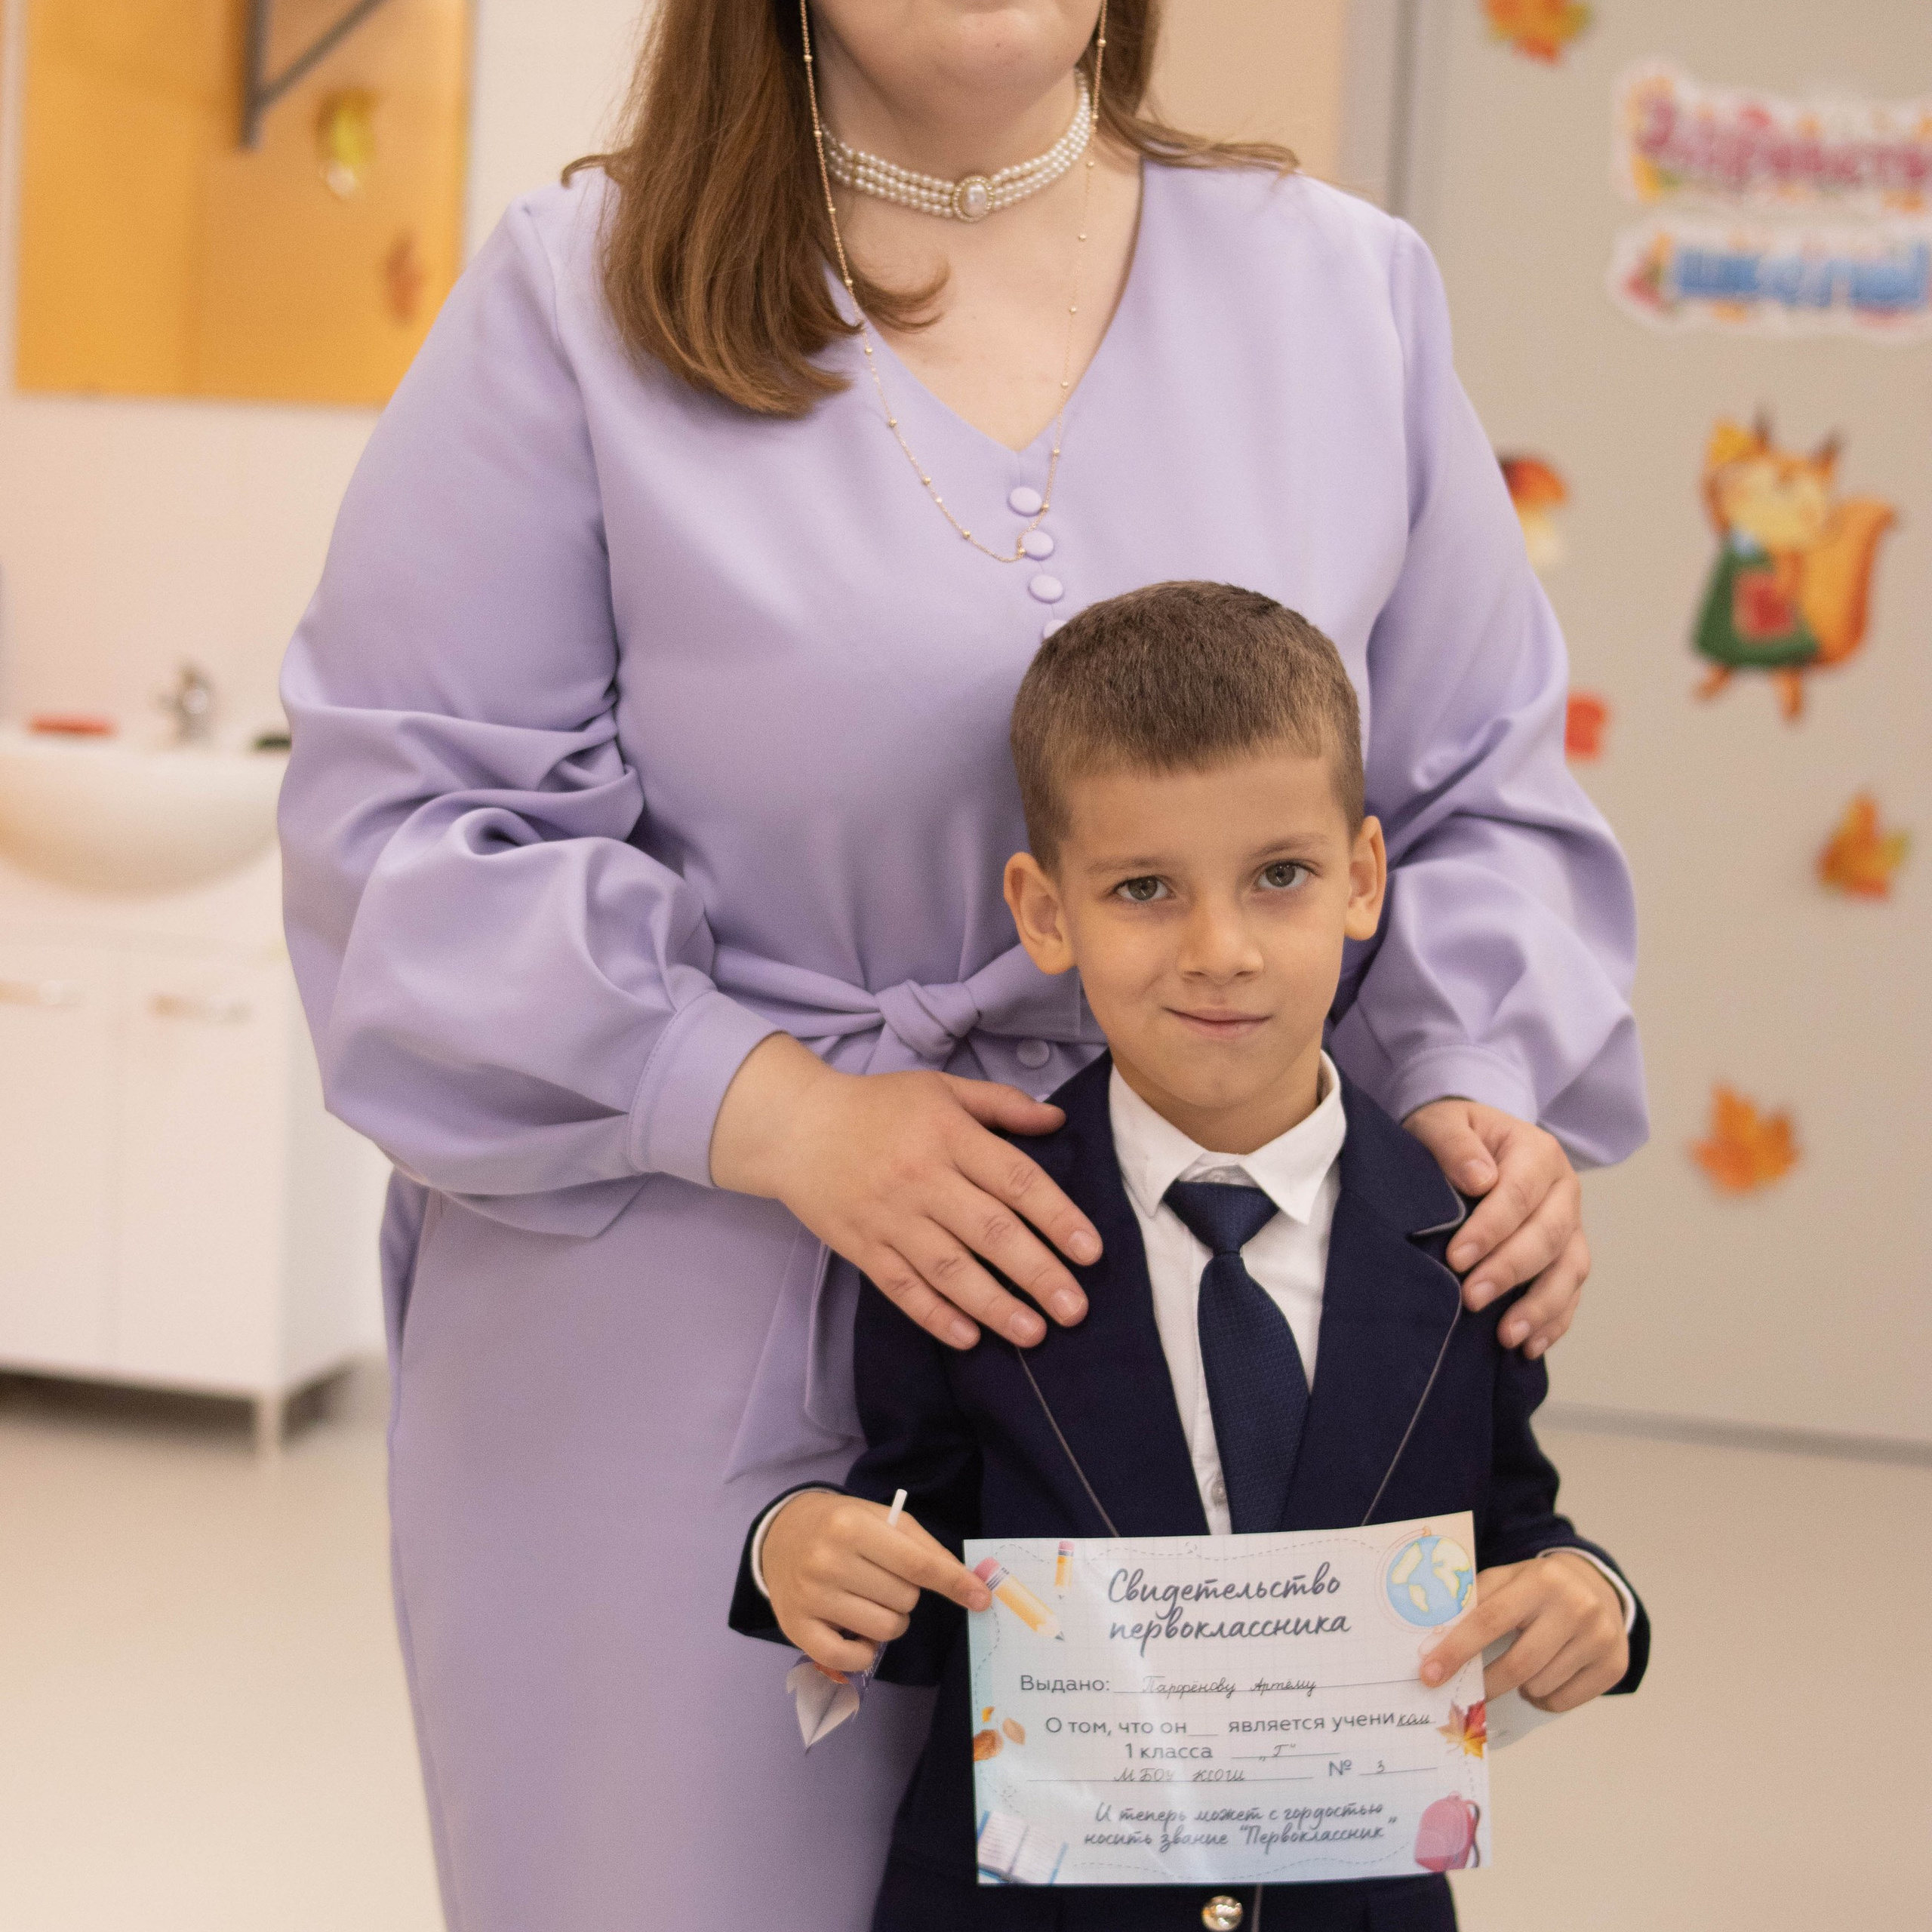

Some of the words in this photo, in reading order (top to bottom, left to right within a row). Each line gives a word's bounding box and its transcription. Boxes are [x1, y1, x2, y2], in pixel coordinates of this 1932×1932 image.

[1108, 1561, 1341, 1620] Свидетельство
[1109, 1606, 1352, 1657] первоклассника
[1020, 1675, 1110, 1693] Выдано:
[1045, 1717, 1062, 1734] О
[1068, 1721, 1112, 1736] том,
[1118, 1721, 1153, 1734] что
[1160, 1721, 1187, 1734] он
[1228, 1716, 1324, 1733] является
[1125, 1743, 1133, 1758] 1
[1140, 1746, 1214, 1759] класса
[1328, 1759, 1353, 1777] №
[1376, 1759, 1386, 1774] 3
[1096, 1801, 1112, 1822] И
[1118, 1807, 1187, 1832] теперь
[1193, 1807, 1263, 1823] может
[1269, 1809, 1278, 1820] с
[1284, 1801, 1383, 1830] гордостью
[1084, 1830, 1153, 1846] носить
[1159, 1824, 1229, 1854] звание
